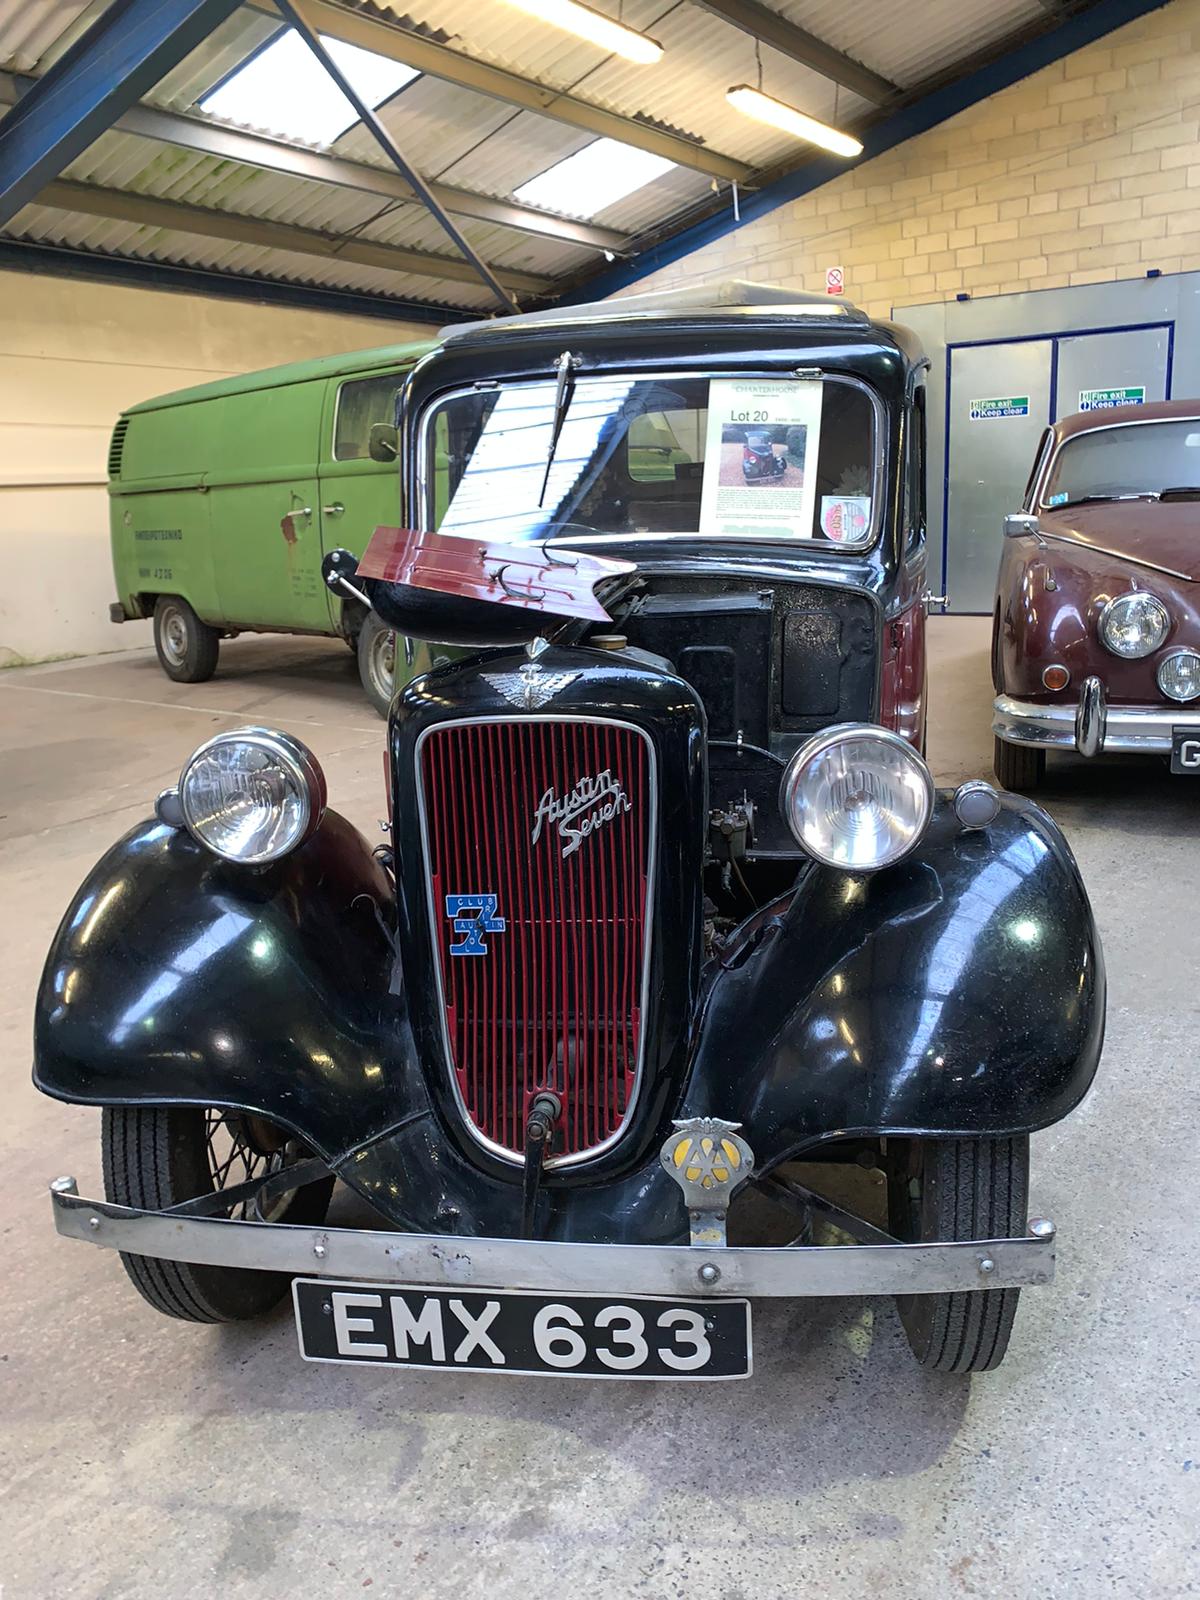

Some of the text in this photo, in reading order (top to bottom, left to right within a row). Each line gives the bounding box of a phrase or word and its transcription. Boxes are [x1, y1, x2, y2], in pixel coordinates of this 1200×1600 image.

[1092, 390, 1126, 401] Fire exit
[981, 400, 1013, 409] Fire exit
[1092, 398, 1138, 409] Keep clear
[731, 410, 750, 422] Lot
[753, 410, 769, 422] 20
[981, 407, 1024, 417] Keep clear
[532, 769, 616, 844] Austin
[559, 783, 632, 859] Seven
[457, 897, 493, 906] CLUB
[331, 1291, 712, 1371] EMX 633
